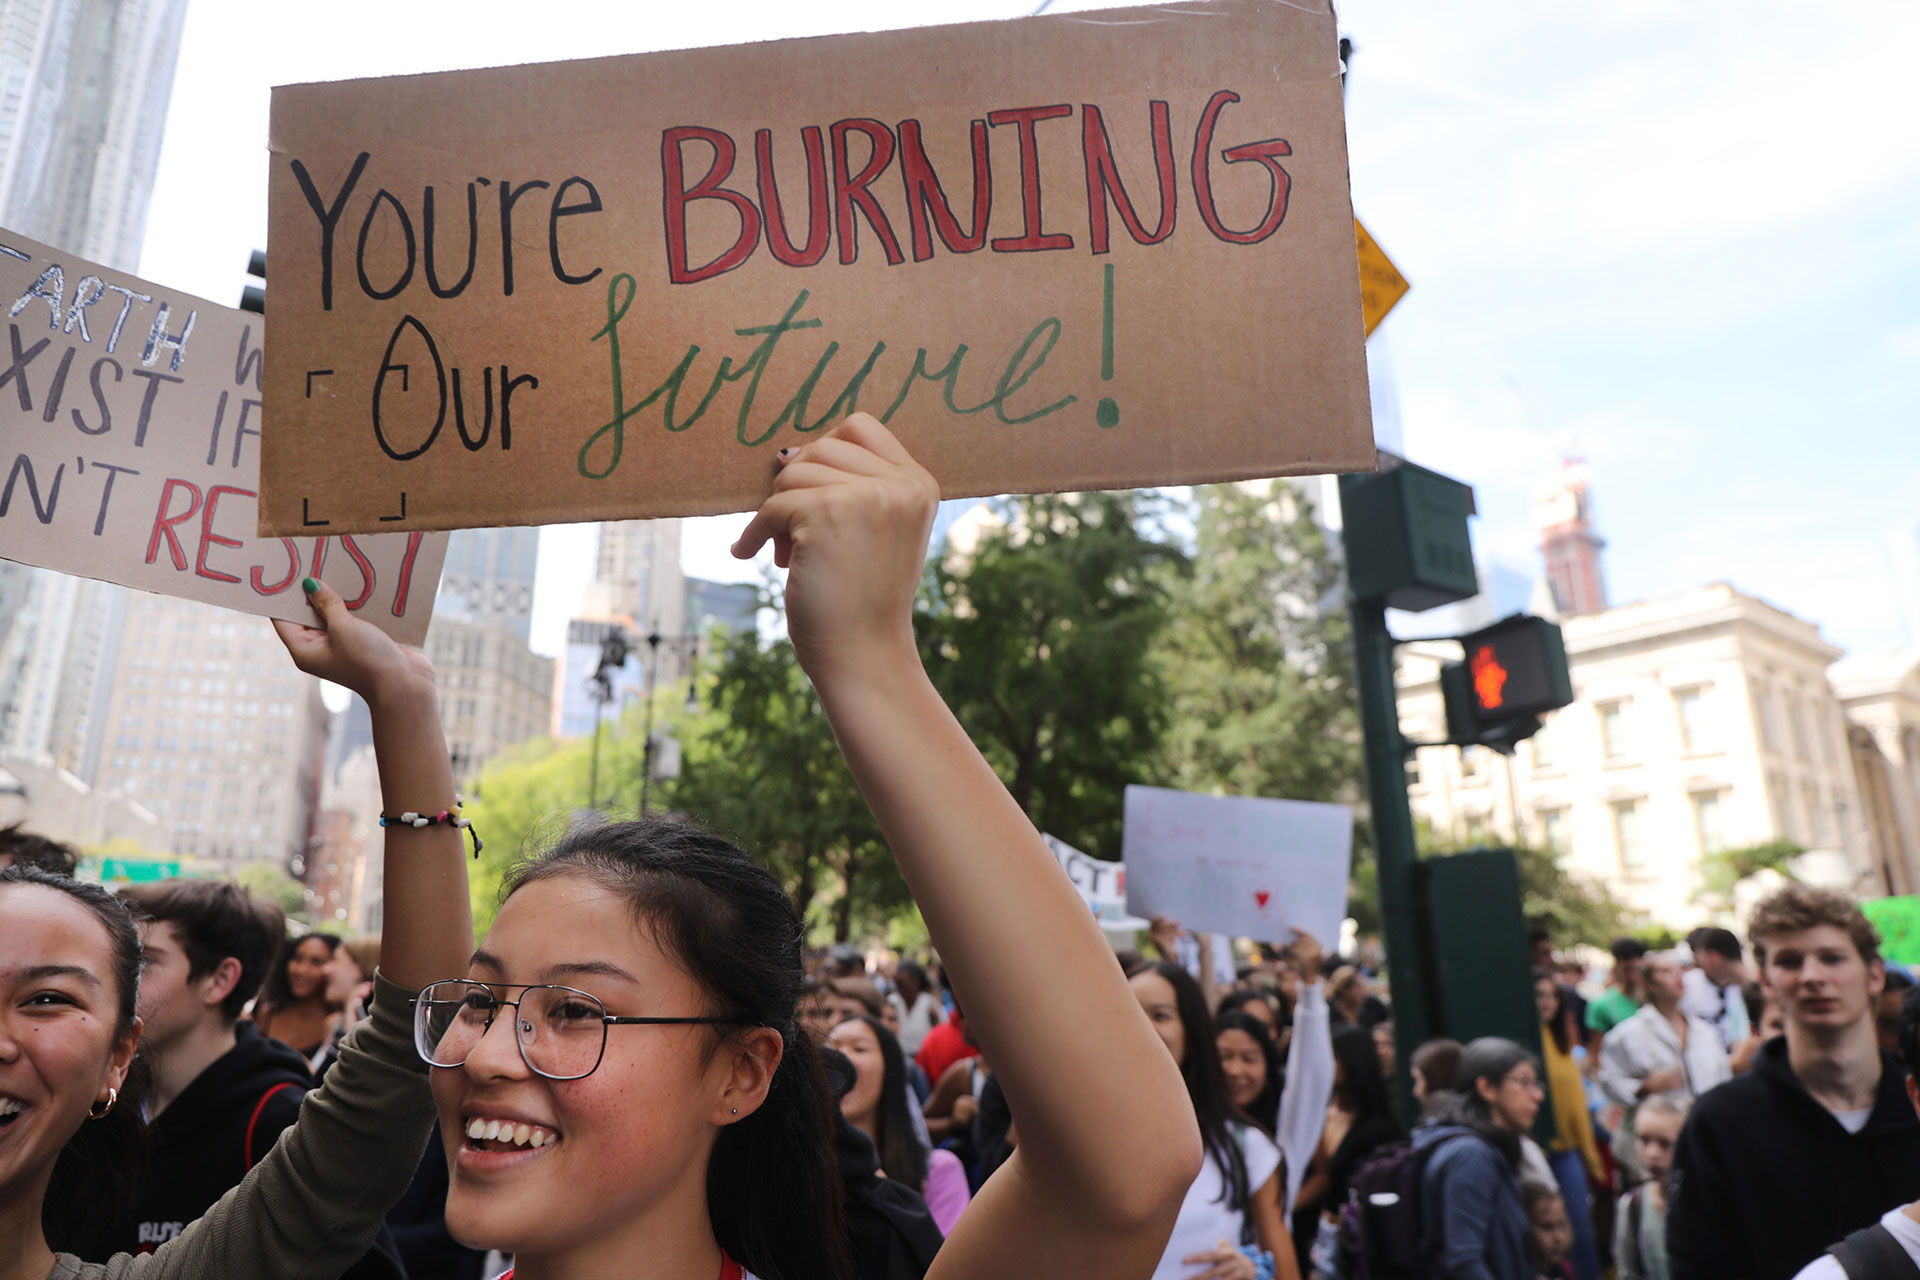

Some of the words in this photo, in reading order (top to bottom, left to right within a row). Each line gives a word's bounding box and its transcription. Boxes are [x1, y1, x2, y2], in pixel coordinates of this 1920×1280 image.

[660, 90, 1292, 284] BURNING
[0, 244, 197, 372] ARTH
[373, 315, 539, 461] Our
[1047, 842, 1110, 893] CT
